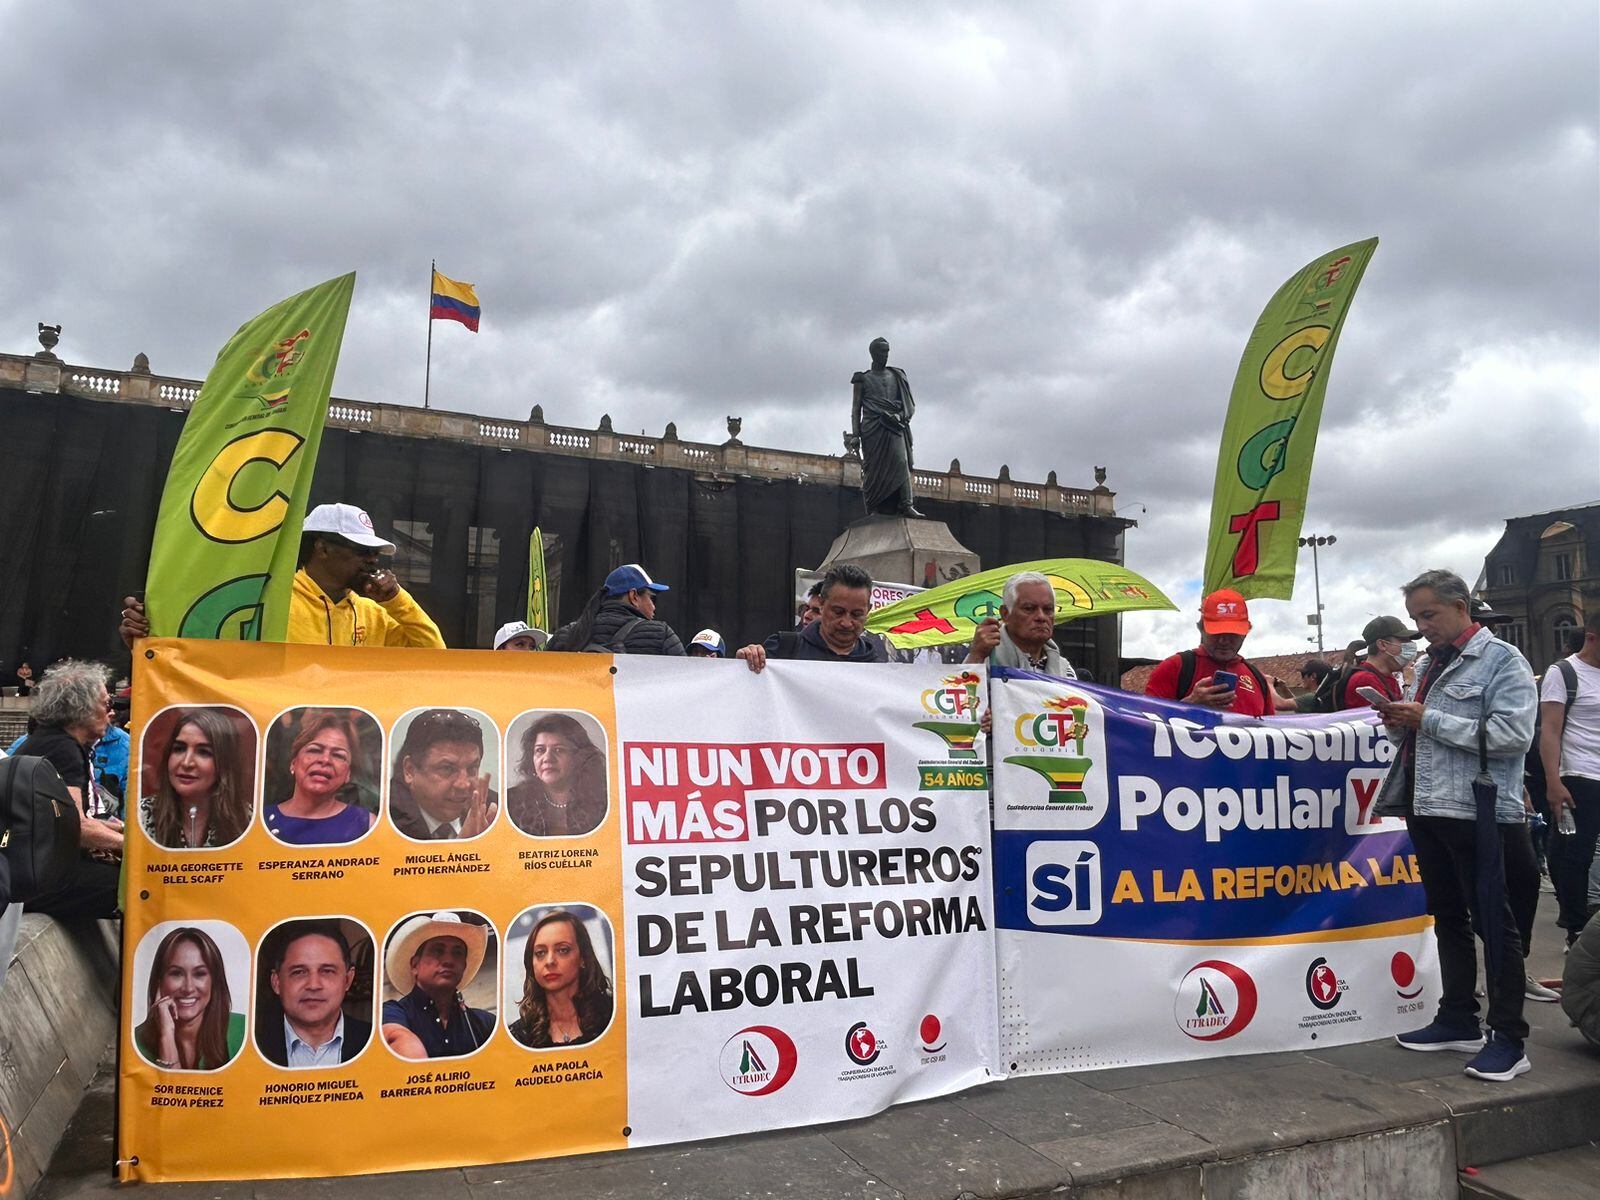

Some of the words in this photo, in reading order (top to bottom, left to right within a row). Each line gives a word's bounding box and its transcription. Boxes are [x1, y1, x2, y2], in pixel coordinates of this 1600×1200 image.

[1216, 603, 1237, 614] ST
[1015, 713, 1074, 746] CGT
[629, 747, 678, 786] NI
[687, 748, 750, 786] UN
[760, 747, 880, 786] VOTO
[925, 773, 944, 786] 54
[947, 769, 984, 786] AÑOS
[1118, 775, 1341, 842] Popular
[1350, 778, 1406, 826] Y
[632, 791, 745, 841] MÁS
[754, 799, 849, 836] POR
[854, 798, 937, 834] LOS
[405, 856, 444, 865] MIGUEL
[445, 853, 481, 863] ÁNGEL
[518, 850, 559, 860] BEATRIZ
[561, 849, 599, 858] LORENA
[146, 864, 179, 873] NADIA
[180, 861, 243, 872] GEORGETTE
[258, 860, 324, 870] ESPERANZA
[326, 857, 380, 868] ANDRADE
[393, 868, 427, 876] PINTO
[428, 863, 490, 875] HERNÁNDEZ
[524, 860, 547, 870] RÍOS
[548, 859, 592, 870] CUÉLLAR
[291, 871, 344, 881] SERRANO
[634, 846, 981, 898] SEPULTUREROS
[163, 876, 189, 884] BLEL
[191, 874, 225, 884] SCAFF
[1030, 851, 1097, 912] SÍ
[1111, 870, 1144, 904] A
[1152, 870, 1206, 903] LA
[1213, 860, 1370, 899] REFORMA
[637, 911, 706, 957] DE
[715, 907, 783, 951] LA
[789, 895, 987, 946] REFORMA
[639, 957, 875, 1019] LABORAL
[1186, 1016, 1229, 1028] UTRADEC
[532, 1064, 555, 1073] ANA
[557, 1060, 589, 1072] PAOLA
[406, 1073, 433, 1084] JOSÉ
[435, 1072, 471, 1082] ALIRIO
[515, 1075, 564, 1087] AGUDELO
[565, 1070, 604, 1084] GARCÍA
[732, 1072, 771, 1085] UTRADEC
[154, 1085, 175, 1094] SOR
[176, 1085, 224, 1096] BERENICE
[265, 1083, 313, 1092] HONORIO
[315, 1080, 359, 1091] MIGUEL
[380, 1086, 432, 1098] BARRERA
[433, 1082, 496, 1096] RODRÍGUEZ
[151, 1097, 190, 1107] BEDOYA
[190, 1096, 224, 1108] PÉREZ
[259, 1093, 321, 1106] HENRÍQUEZ
[323, 1091, 364, 1102] PINEDA
